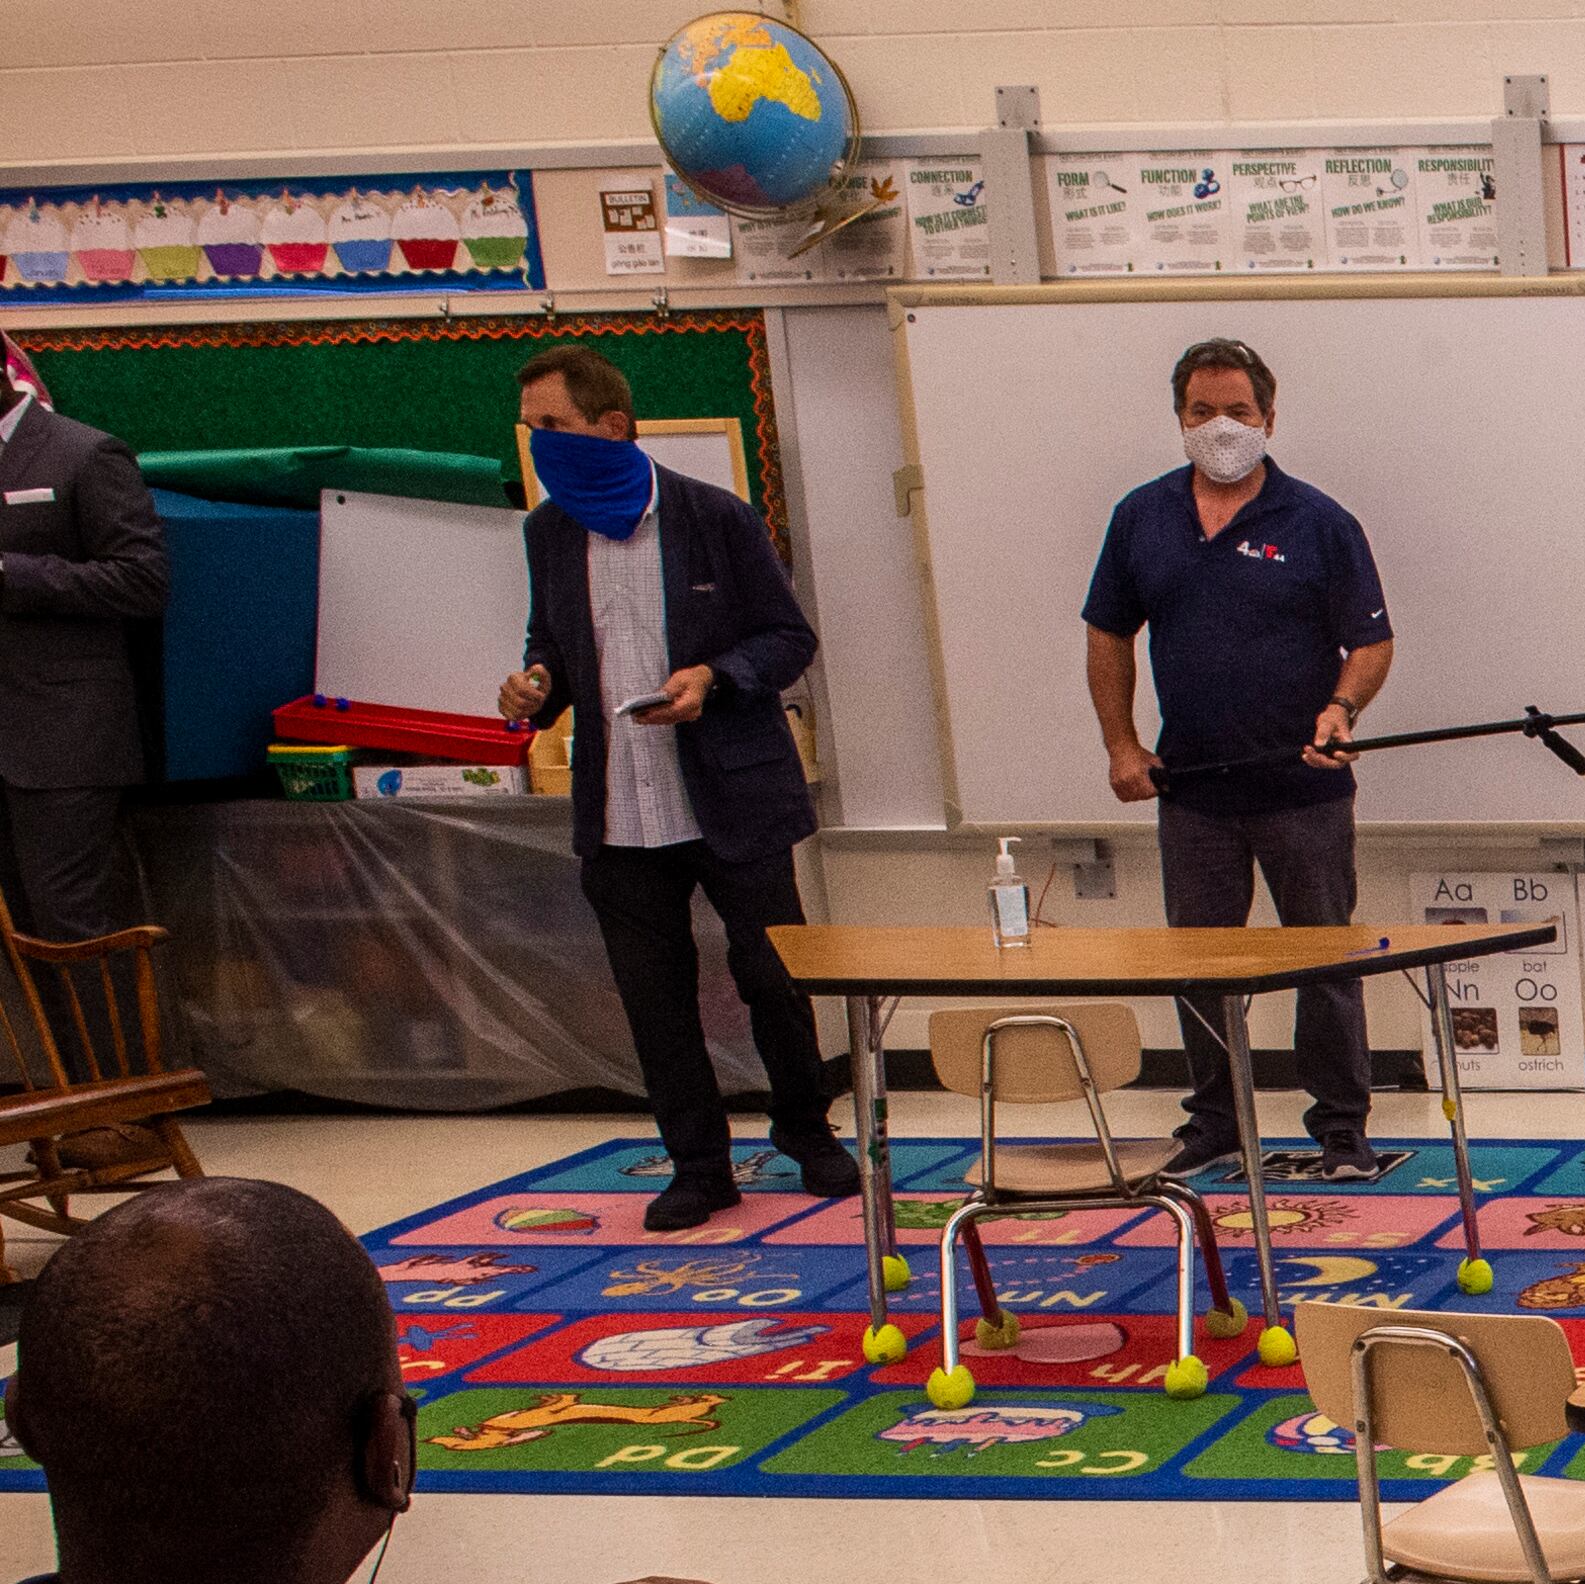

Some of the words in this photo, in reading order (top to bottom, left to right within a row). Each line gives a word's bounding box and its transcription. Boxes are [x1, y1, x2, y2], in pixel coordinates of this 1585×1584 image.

[1232, 162, 1297, 176] PERSPECTIVE
[1325, 158, 1392, 174] REFLECTION
[910, 170, 973, 184] CONNECTION
[1057, 171, 1090, 187] FORM
[1141, 169, 1197, 184] FUNCTION
[1065, 206, 1088, 222] WHAT
[1331, 206, 1350, 219] HOW
[1351, 204, 1364, 215] DO
[1364, 202, 1376, 213] WE
[1435, 879, 1473, 901] Aa
[1513, 879, 1549, 901] Bb
[1523, 960, 1547, 973] bat
[1515, 978, 1558, 1001] Oo
[1518, 1059, 1564, 1071] ostrich
[401, 1289, 507, 1307] Pp
[692, 1288, 803, 1307] Oo
[765, 1360, 854, 1381] Ii
[595, 1444, 741, 1469] Dd
[1034, 1449, 1149, 1475] Cc
